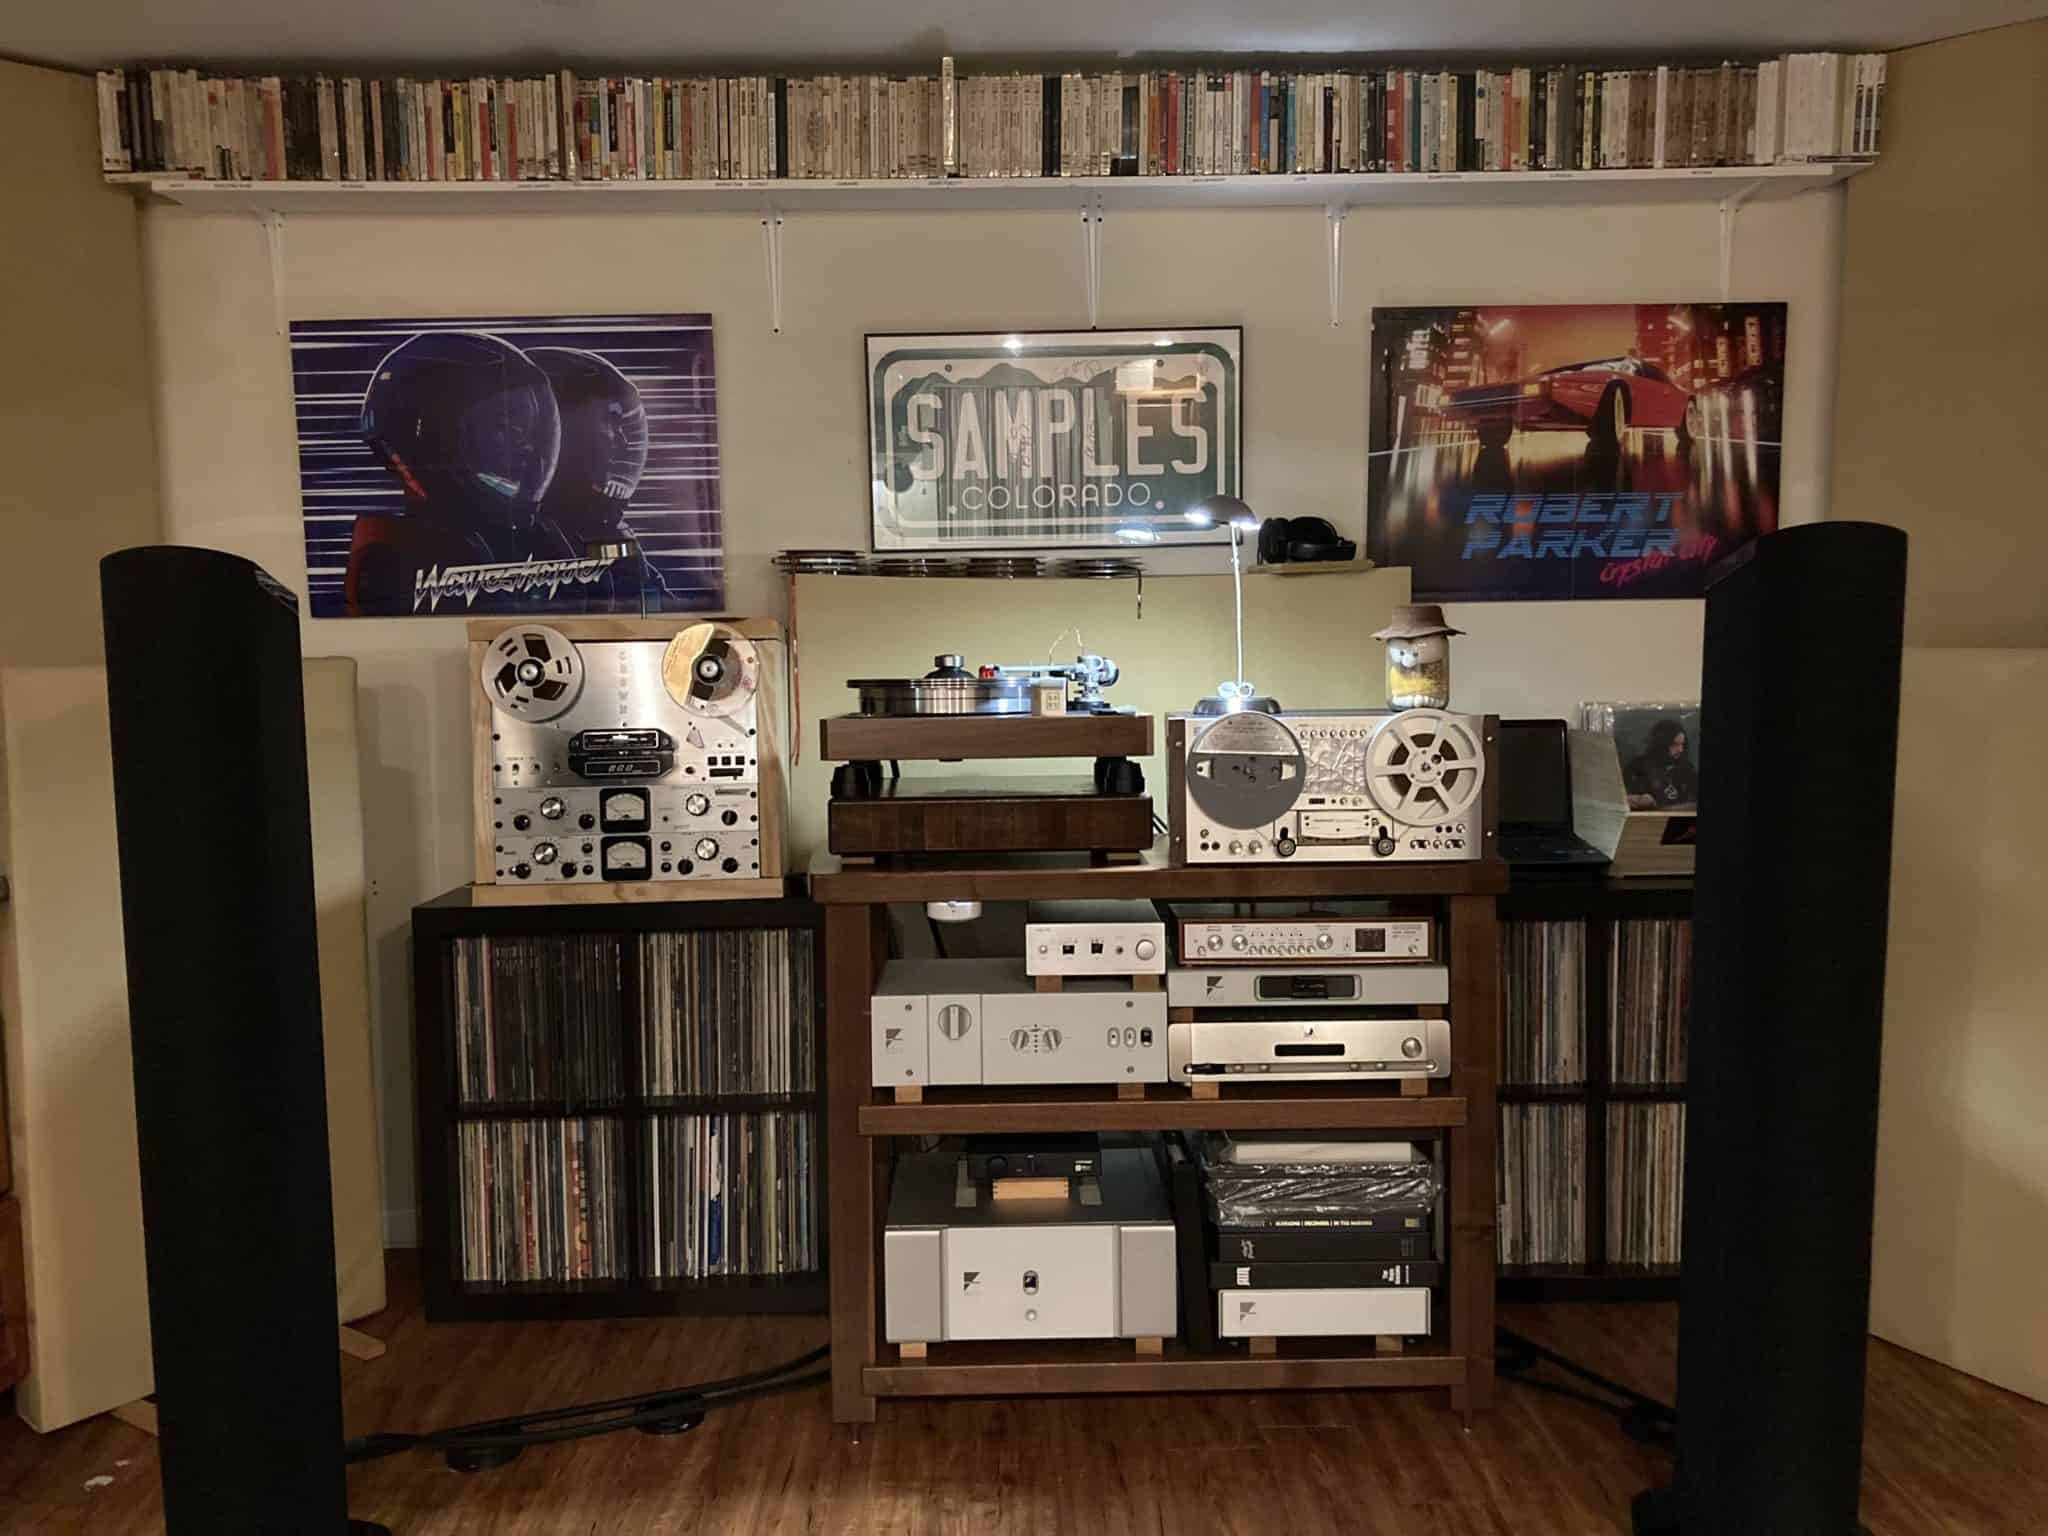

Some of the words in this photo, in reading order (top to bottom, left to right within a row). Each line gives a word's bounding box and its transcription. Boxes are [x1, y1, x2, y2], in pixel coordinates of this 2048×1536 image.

[906, 387, 1208, 481] SAMPLES
[961, 482, 1151, 510] COLORADO
[1464, 492, 1684, 523] ROBERT
[1461, 528, 1679, 560] PARKER
